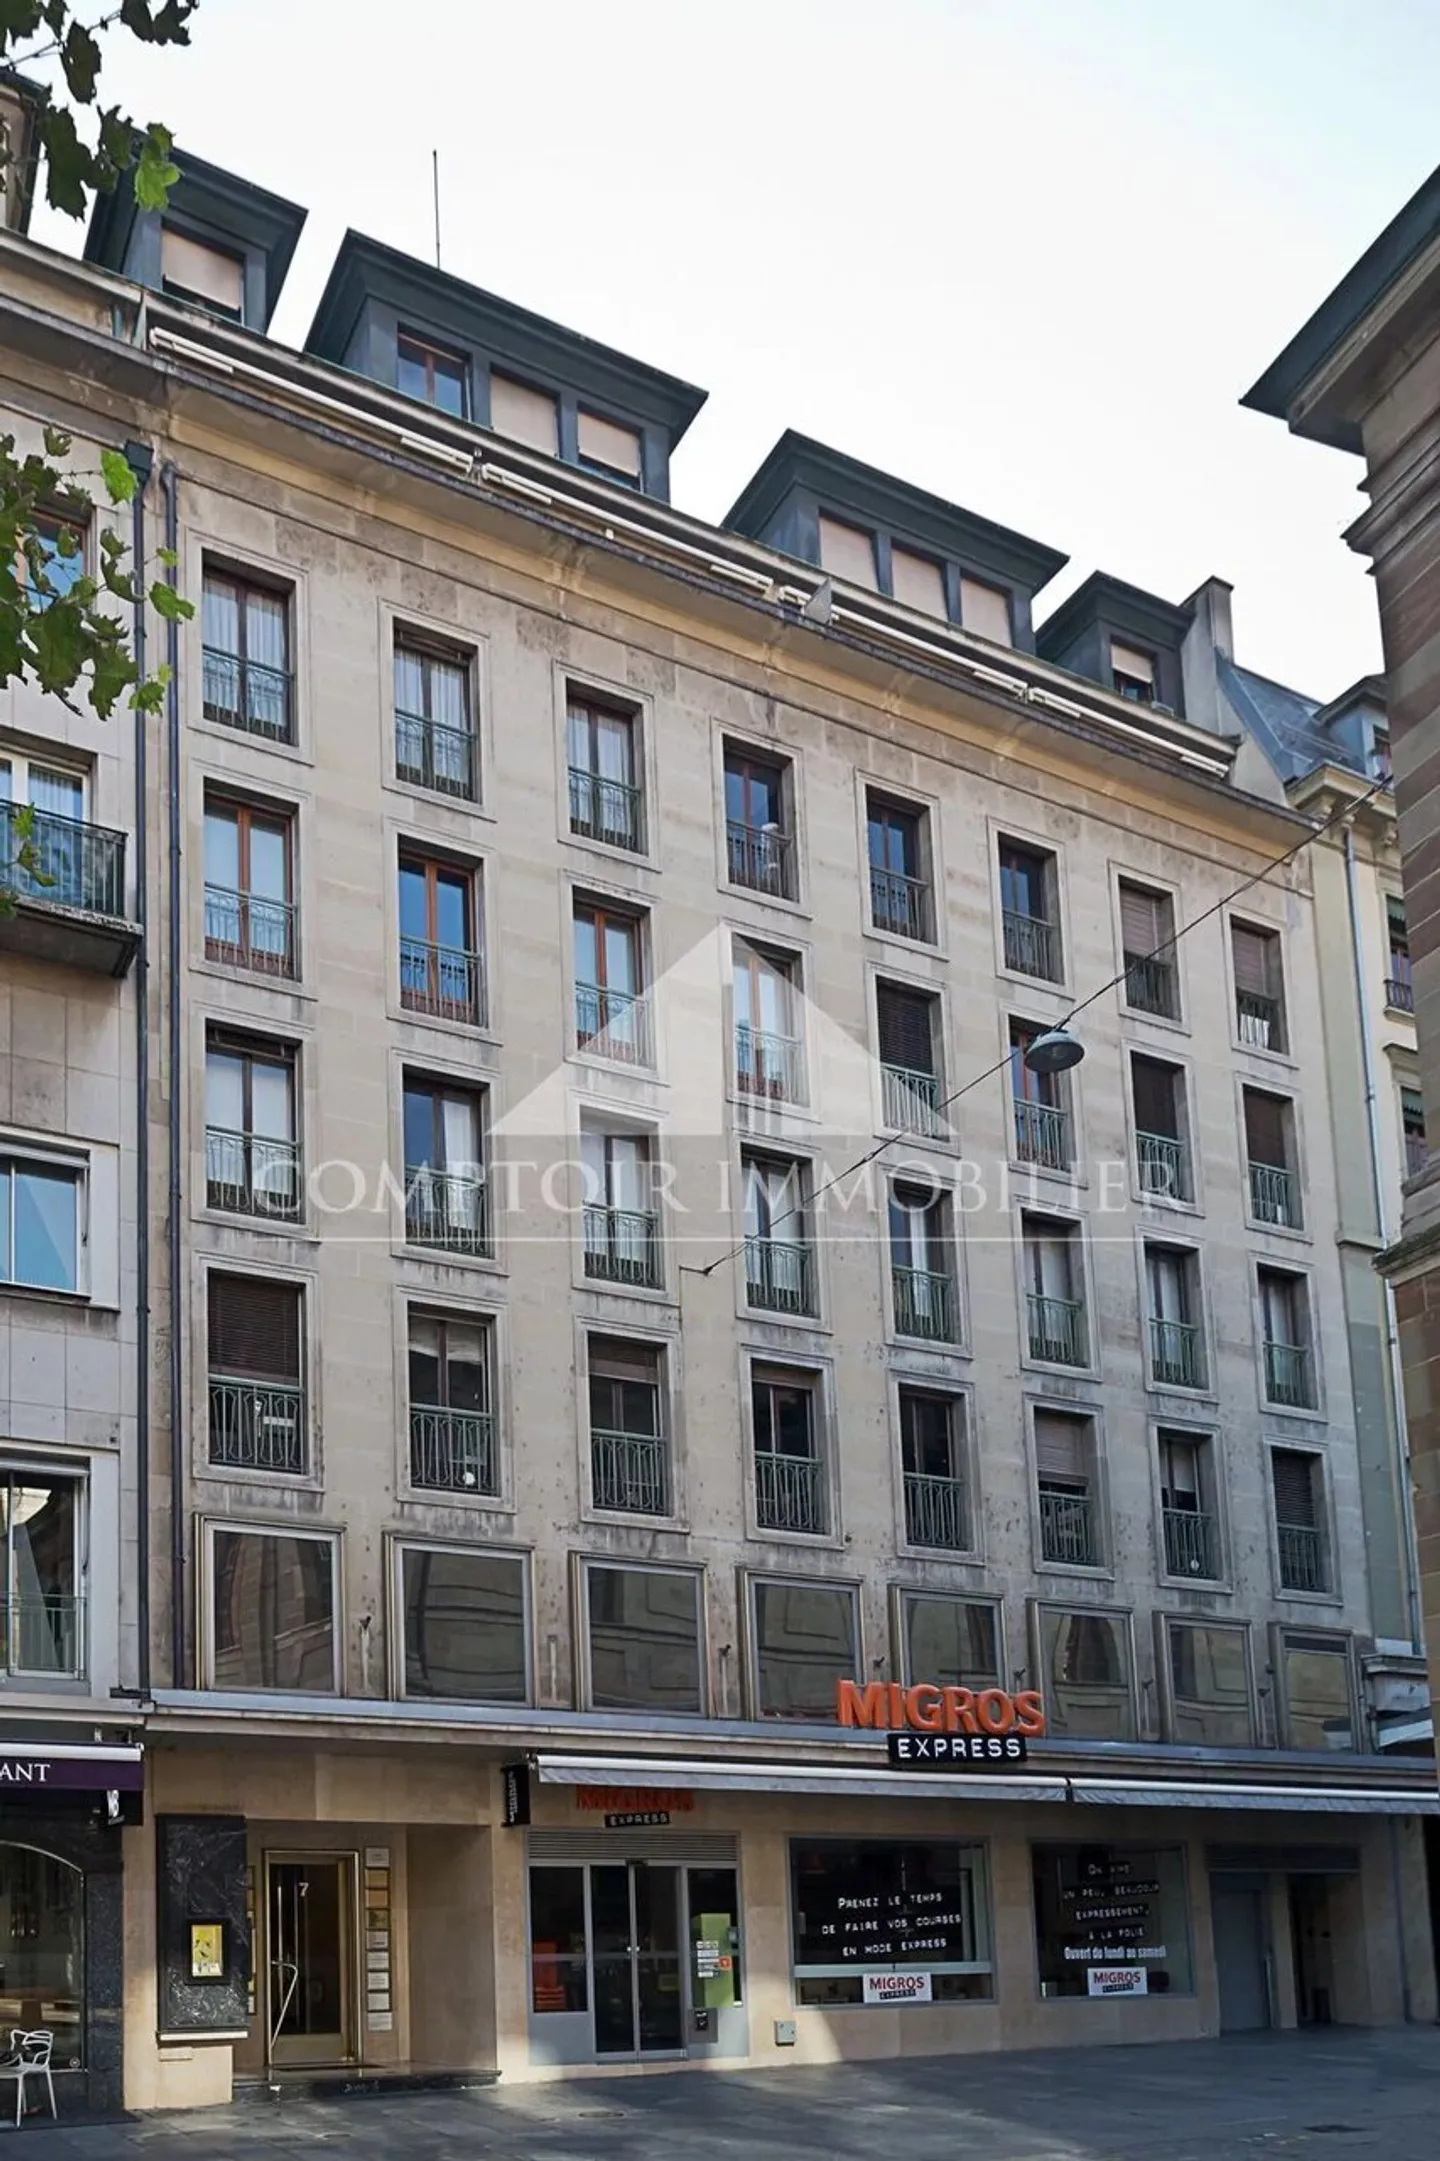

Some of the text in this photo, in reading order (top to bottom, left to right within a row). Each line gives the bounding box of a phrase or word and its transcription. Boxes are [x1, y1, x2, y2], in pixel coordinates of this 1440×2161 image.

[837, 1679, 1045, 1736] MIGROS
[897, 1738, 1021, 1758] EXPRESS
[0, 1762, 51, 1782] ANT
[609, 1813, 668, 1827] EXPRESS
[298, 1882, 309, 1897] 7
[888, 1895, 900, 1906] LE
[910, 1892, 942, 1904] TEMPS
[821, 1914, 961, 1935] DE FAIRE VOS COURSES
[842, 1938, 947, 1957] EN MODE EXPRESS
[870, 1976, 925, 1990] MIGROS
[1094, 1971, 1141, 1984] MIGROS
